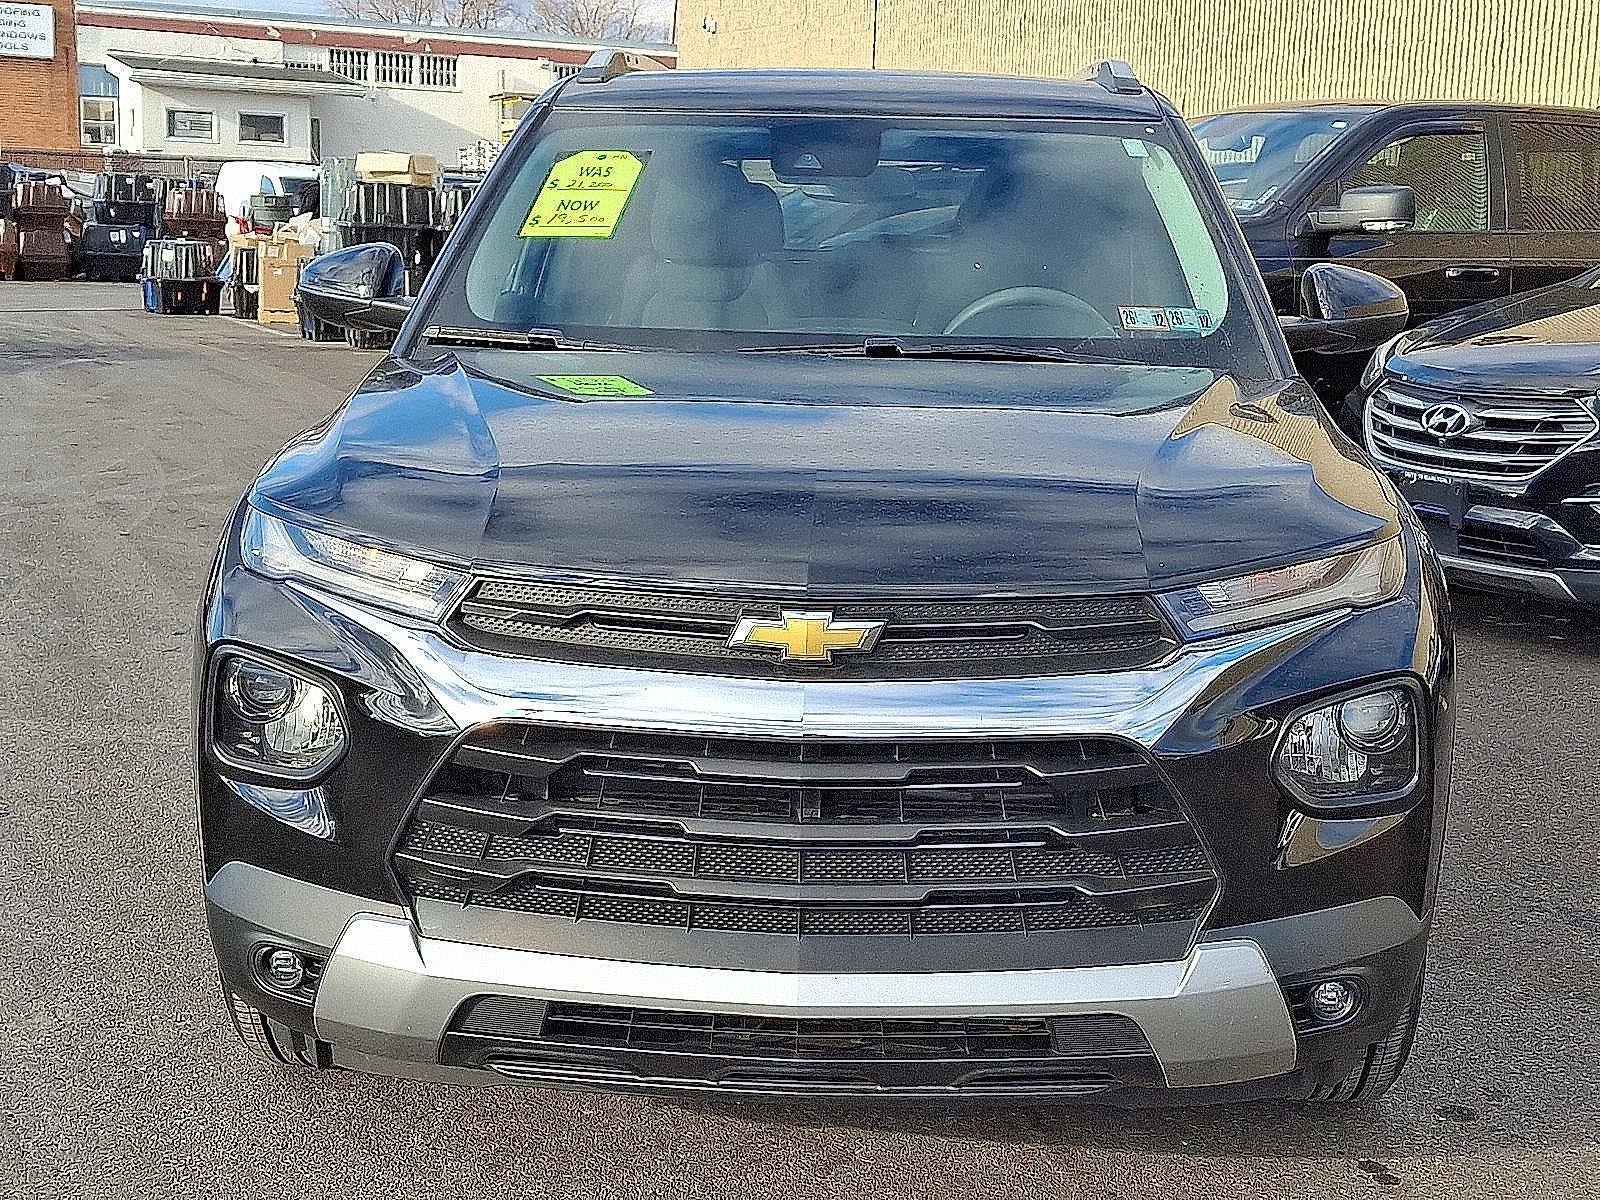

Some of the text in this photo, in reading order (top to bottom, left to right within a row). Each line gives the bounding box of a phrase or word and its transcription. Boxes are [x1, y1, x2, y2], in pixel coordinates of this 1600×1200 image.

[579, 166, 613, 177] WAS
[547, 179, 559, 190] $
[556, 199, 601, 211] NOW
[529, 214, 541, 227] $
[1152, 313, 1167, 327] 12
[1198, 314, 1212, 328] 12
